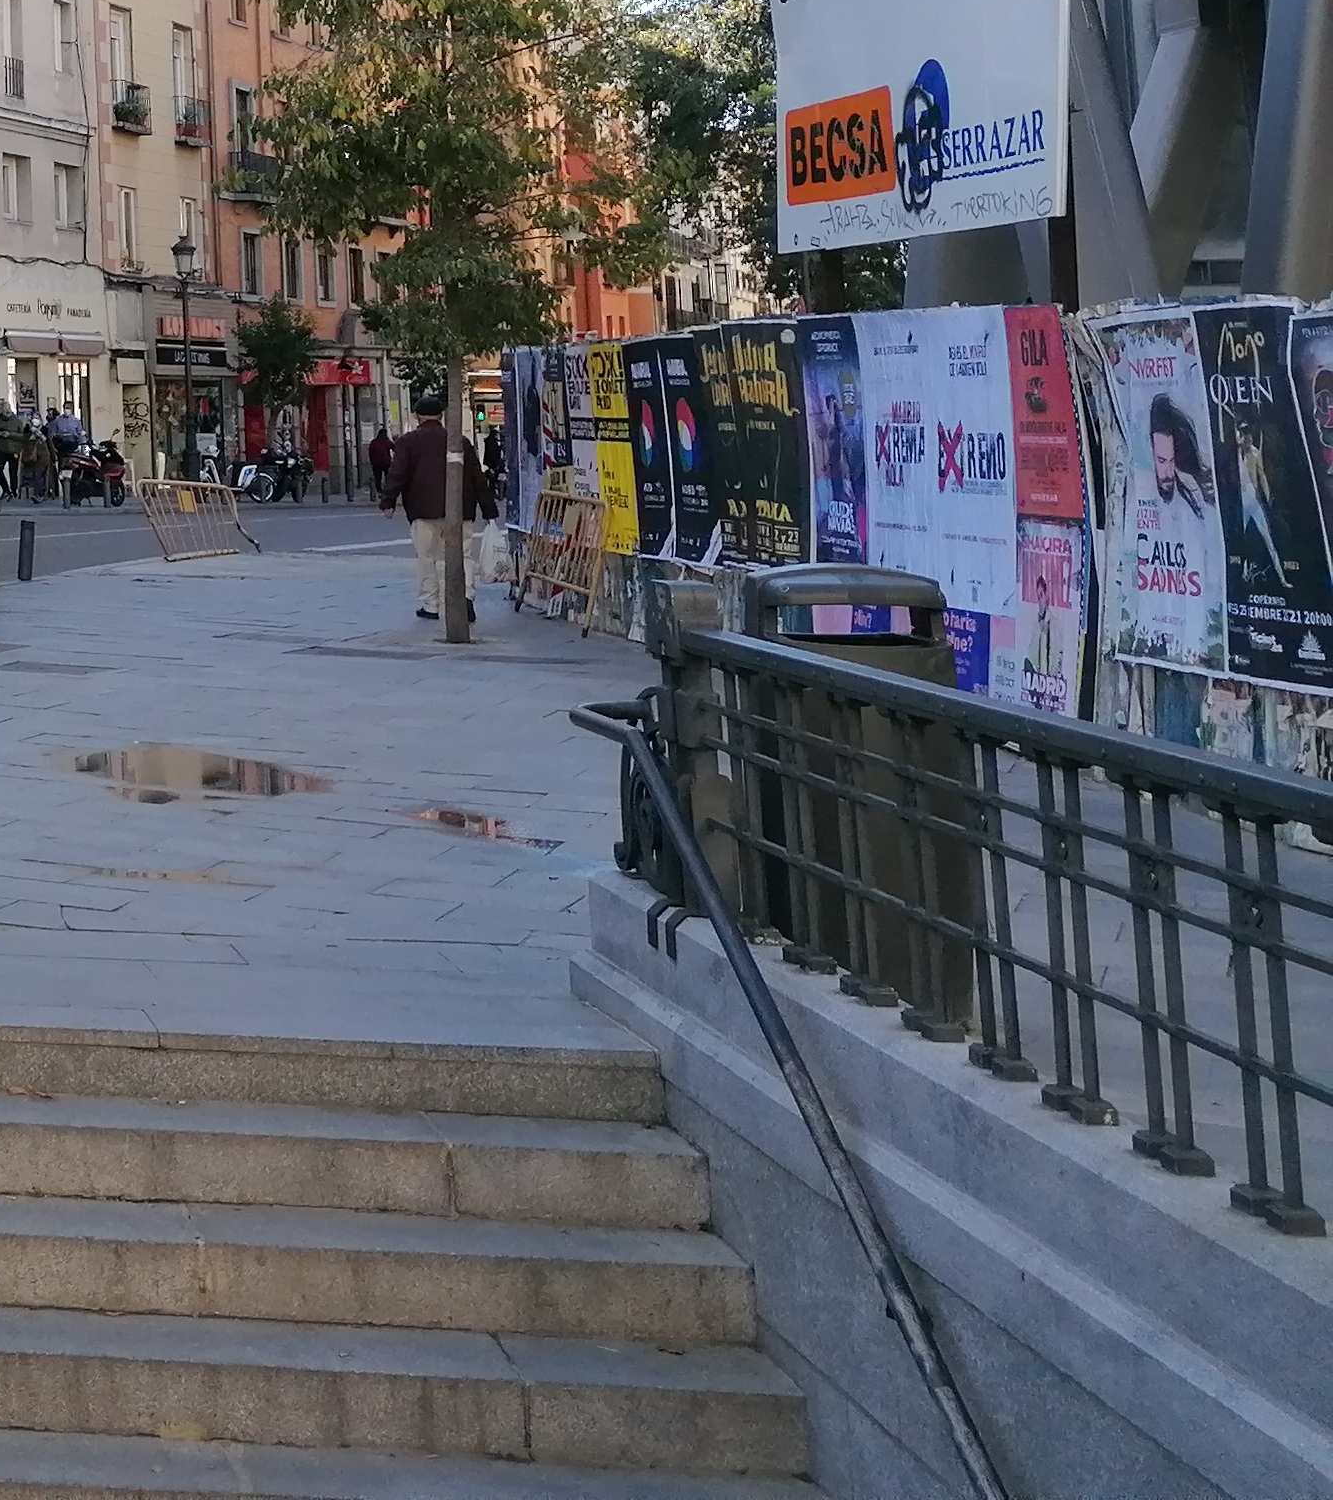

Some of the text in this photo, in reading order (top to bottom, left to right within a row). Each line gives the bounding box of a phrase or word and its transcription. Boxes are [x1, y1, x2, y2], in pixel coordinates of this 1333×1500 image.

[789, 108, 888, 188] BECSA
[941, 108, 1045, 170] SERRAZAR
[1020, 329, 1049, 367] GILA
